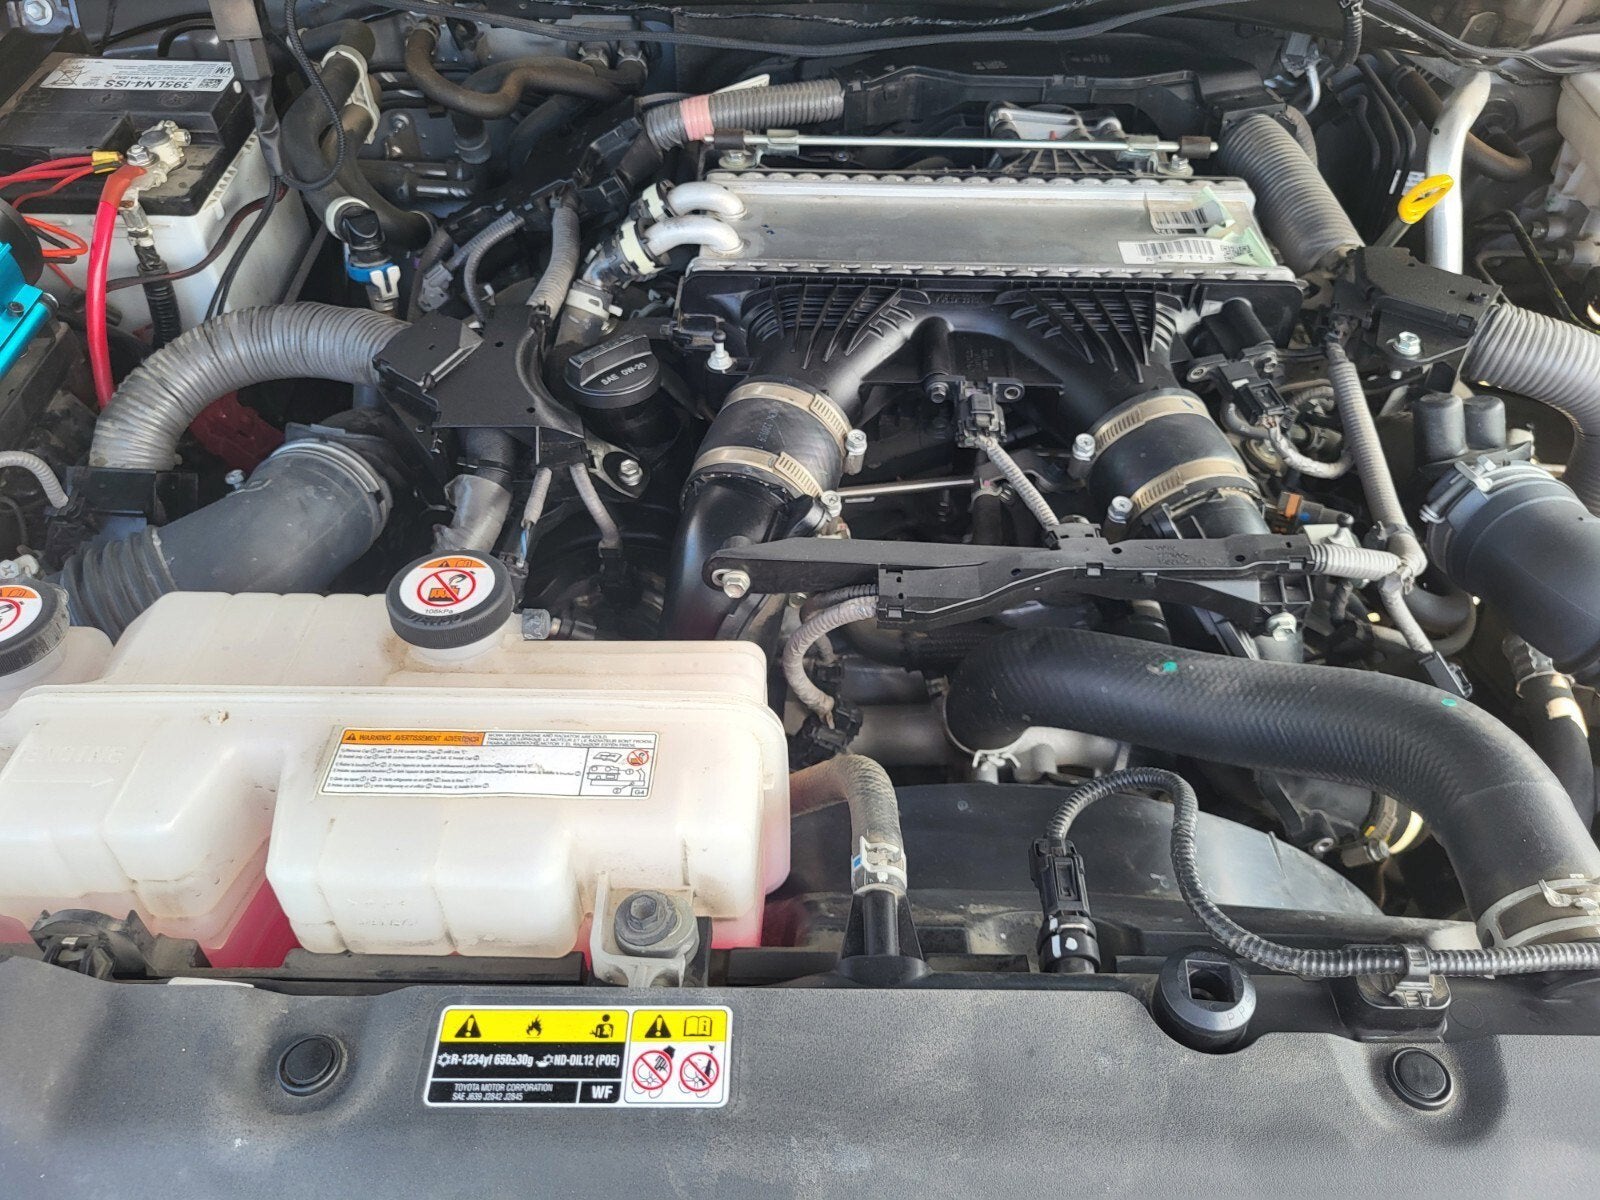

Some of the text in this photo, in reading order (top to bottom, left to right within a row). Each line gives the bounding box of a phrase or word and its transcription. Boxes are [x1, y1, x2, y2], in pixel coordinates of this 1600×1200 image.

[104, 80, 193, 89] 395LN4-ISS
[600, 362, 648, 386] SAE 0W-20
[634, 788, 645, 796] G4
[451, 1053, 493, 1067] R-1234yf
[494, 1053, 534, 1067] 650±30g
[595, 1054, 620, 1068] (POE)
[454, 1083, 554, 1092] TOYOTA MOTOR CORPORATION
[452, 1092, 524, 1101] SAE J639 J2842 J2845
[591, 1085, 614, 1100] WF
